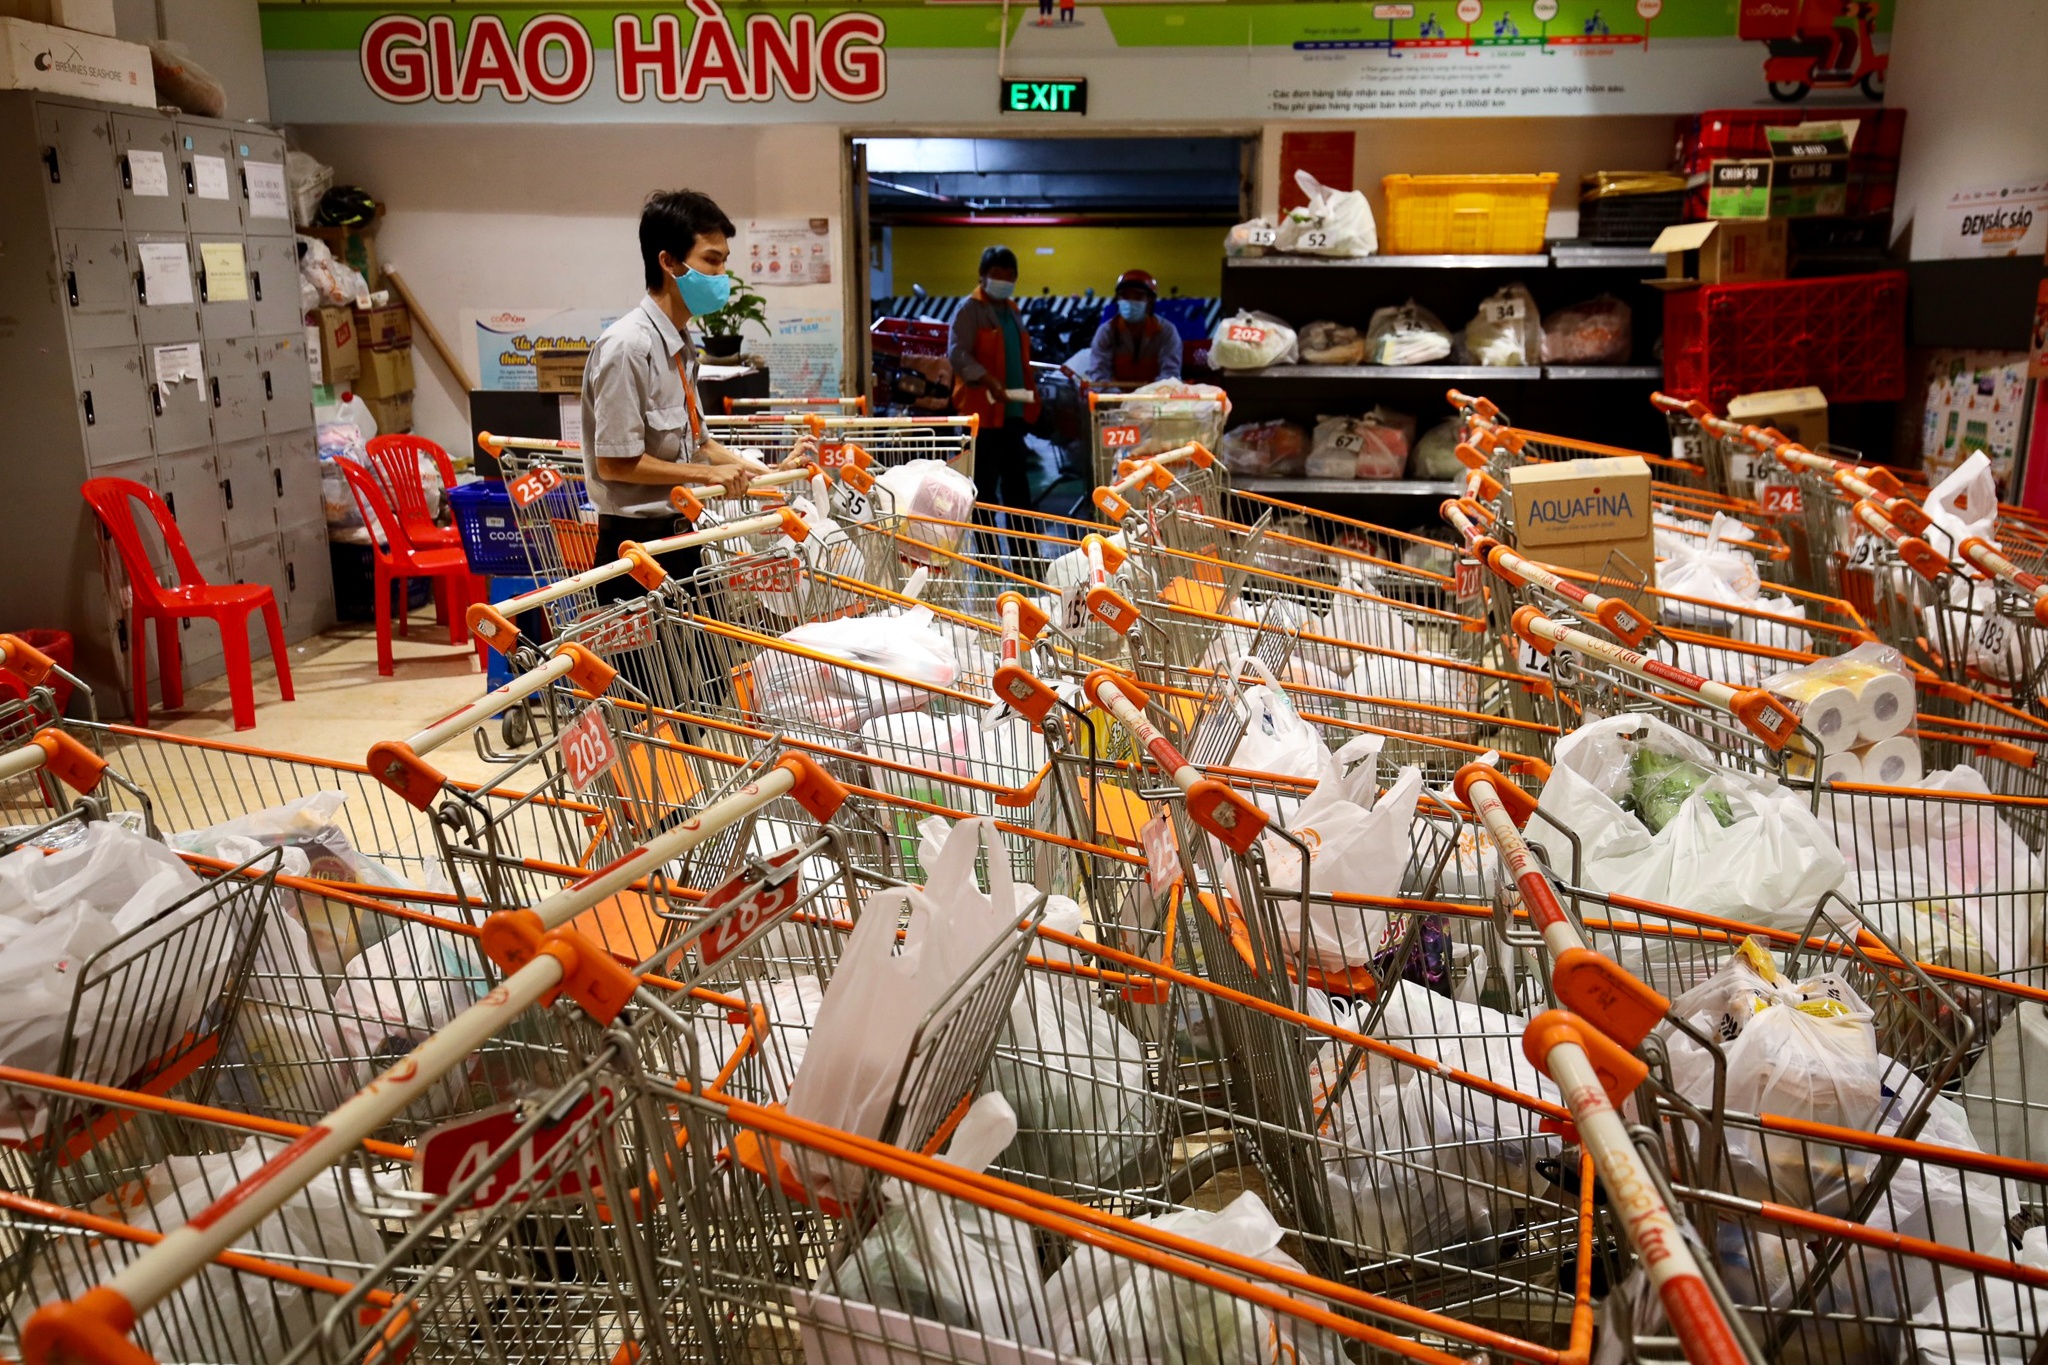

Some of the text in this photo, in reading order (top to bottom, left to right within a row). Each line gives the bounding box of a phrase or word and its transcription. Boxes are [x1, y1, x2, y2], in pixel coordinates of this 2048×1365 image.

[361, 0, 884, 102] GIAO HÀNG
[55, 61, 88, 76] BREMNES
[88, 67, 122, 82] SEASHORE
[1010, 83, 1076, 111] EXIT
[1254, 231, 1270, 243] 15
[1308, 233, 1326, 246] 52
[1497, 305, 1514, 319] 34
[1232, 328, 1262, 341] 202
[1107, 430, 1136, 446] 274
[1335, 435, 1354, 448] 67
[1683, 441, 1702, 455] 51
[517, 470, 555, 503] 259
[841, 490, 866, 515] 35
[1528, 487, 1633, 527] AQUAFINA
[1979, 619, 2004, 655] 183
[1758, 710, 1776, 728] 314
[570, 724, 607, 782] 203
